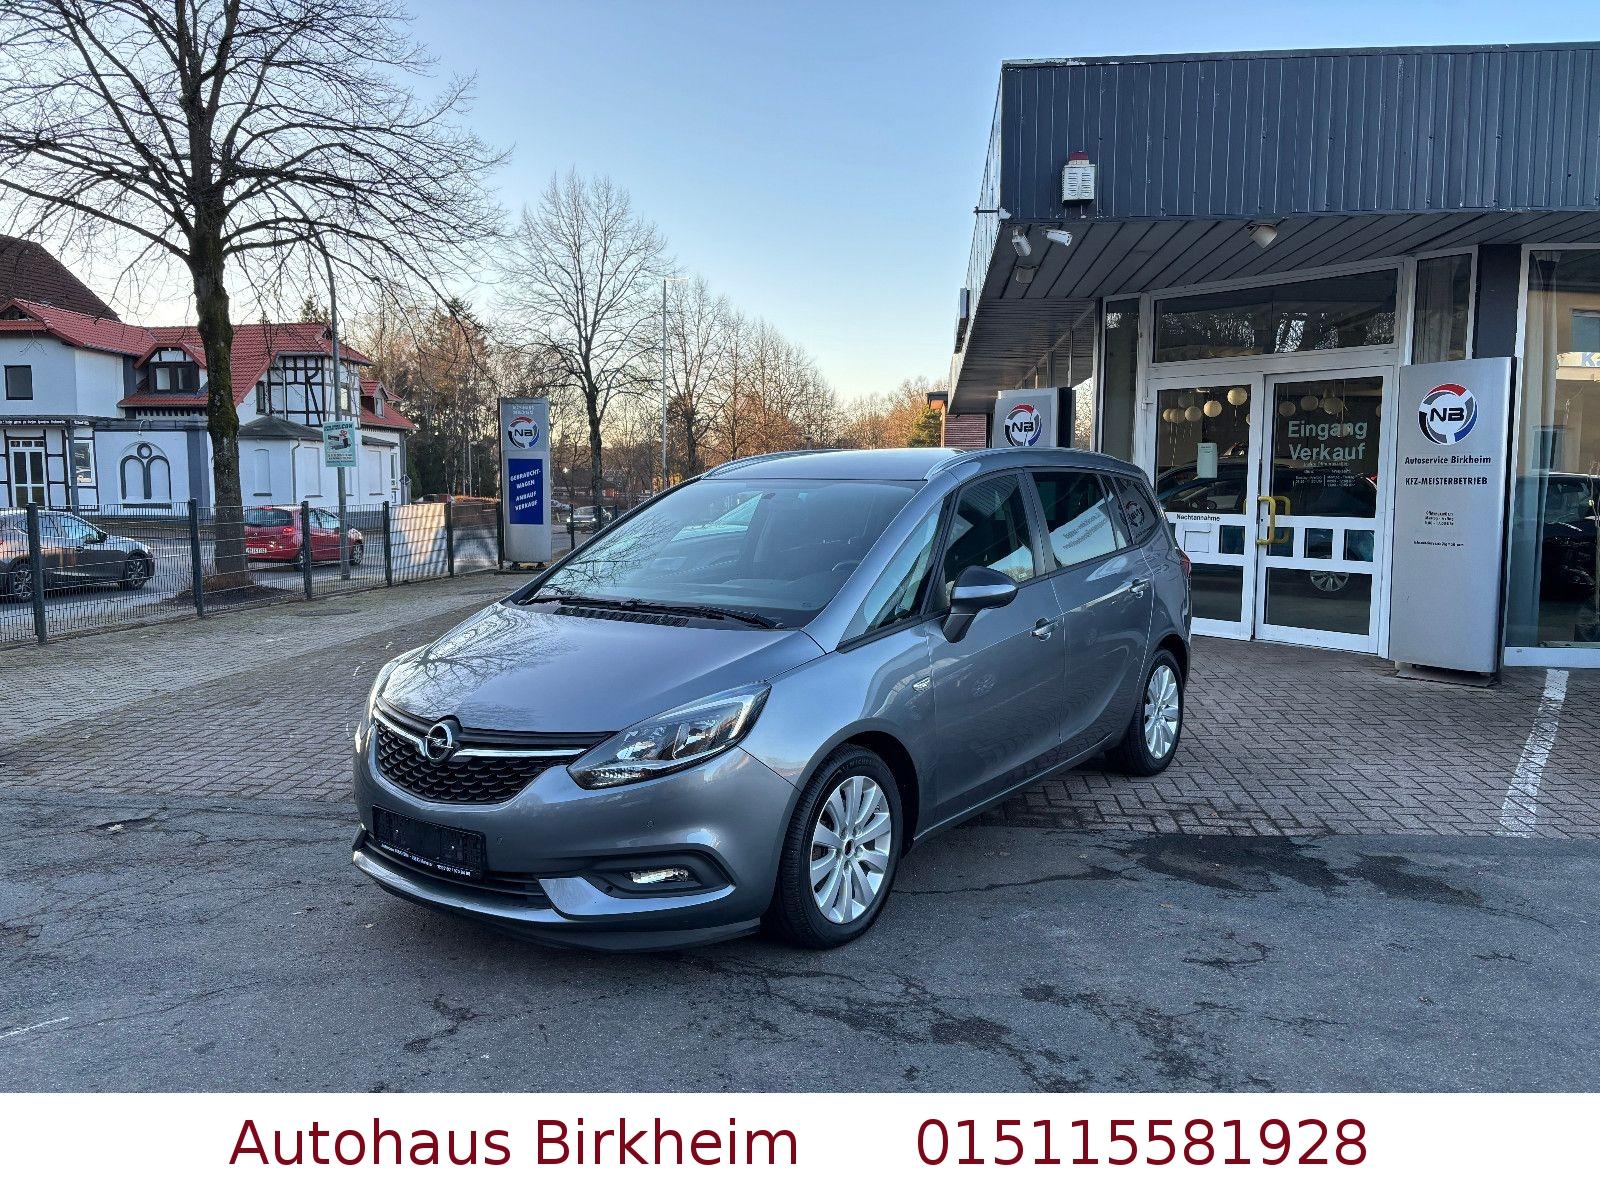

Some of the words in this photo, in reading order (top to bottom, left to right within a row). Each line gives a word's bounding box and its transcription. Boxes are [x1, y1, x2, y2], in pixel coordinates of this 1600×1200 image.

[1429, 407, 1465, 423] NB
[514, 429, 533, 437] NB
[1011, 421, 1035, 433] NB
[1287, 420, 1368, 440] Eingang
[1288, 443, 1366, 460] Verkauf
[1404, 456, 1449, 465] Autoservice
[1450, 455, 1491, 464] Birkheim
[1405, 477, 1488, 486] KFZ-MEISTERBETRIEB
